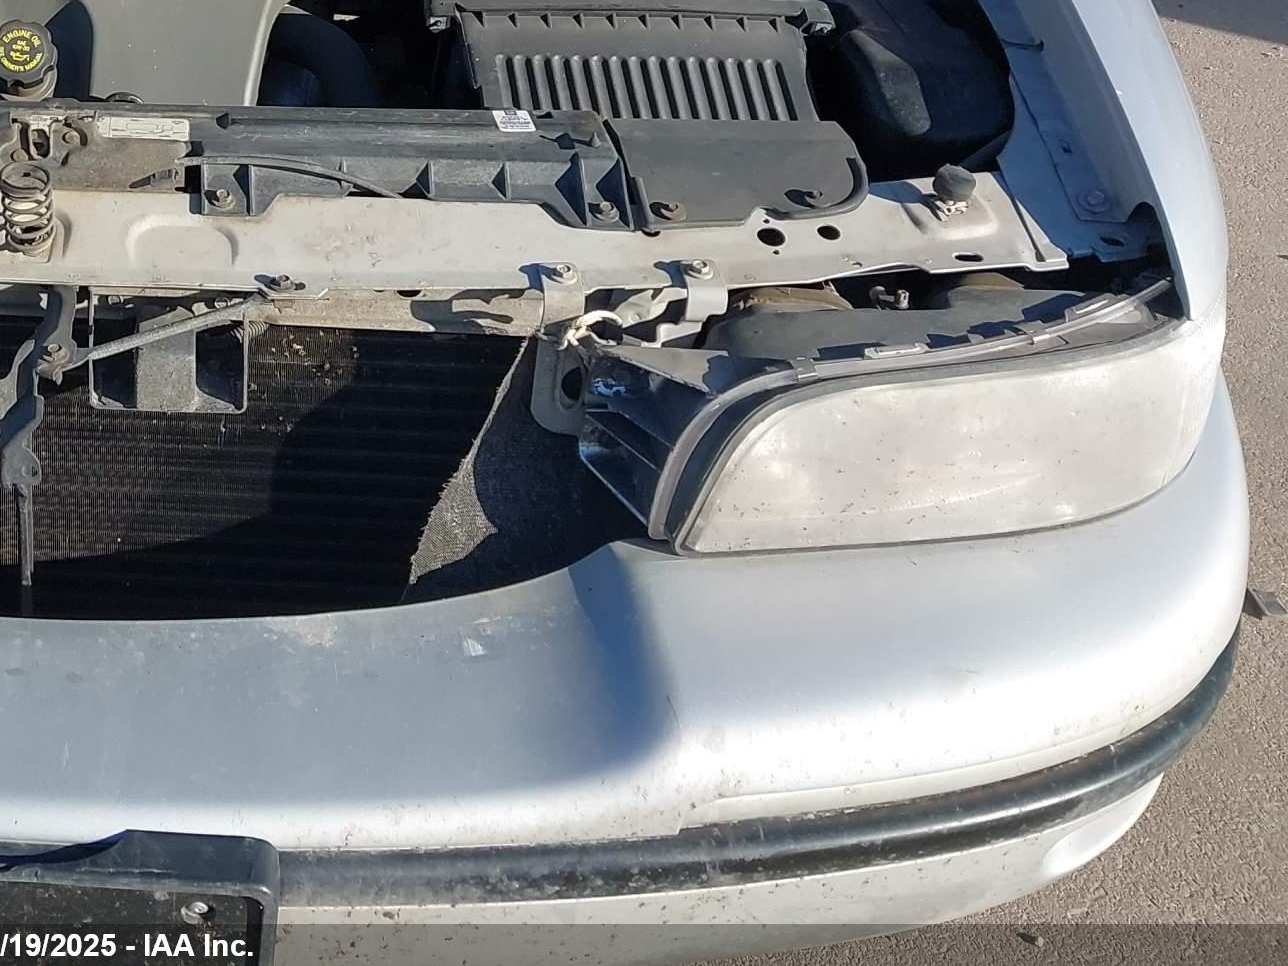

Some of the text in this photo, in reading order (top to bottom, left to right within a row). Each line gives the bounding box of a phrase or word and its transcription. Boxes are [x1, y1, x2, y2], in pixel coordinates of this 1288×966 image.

[2, 30, 41, 48] ENGINE OIL
[24, 53, 42, 70] MANUAL
